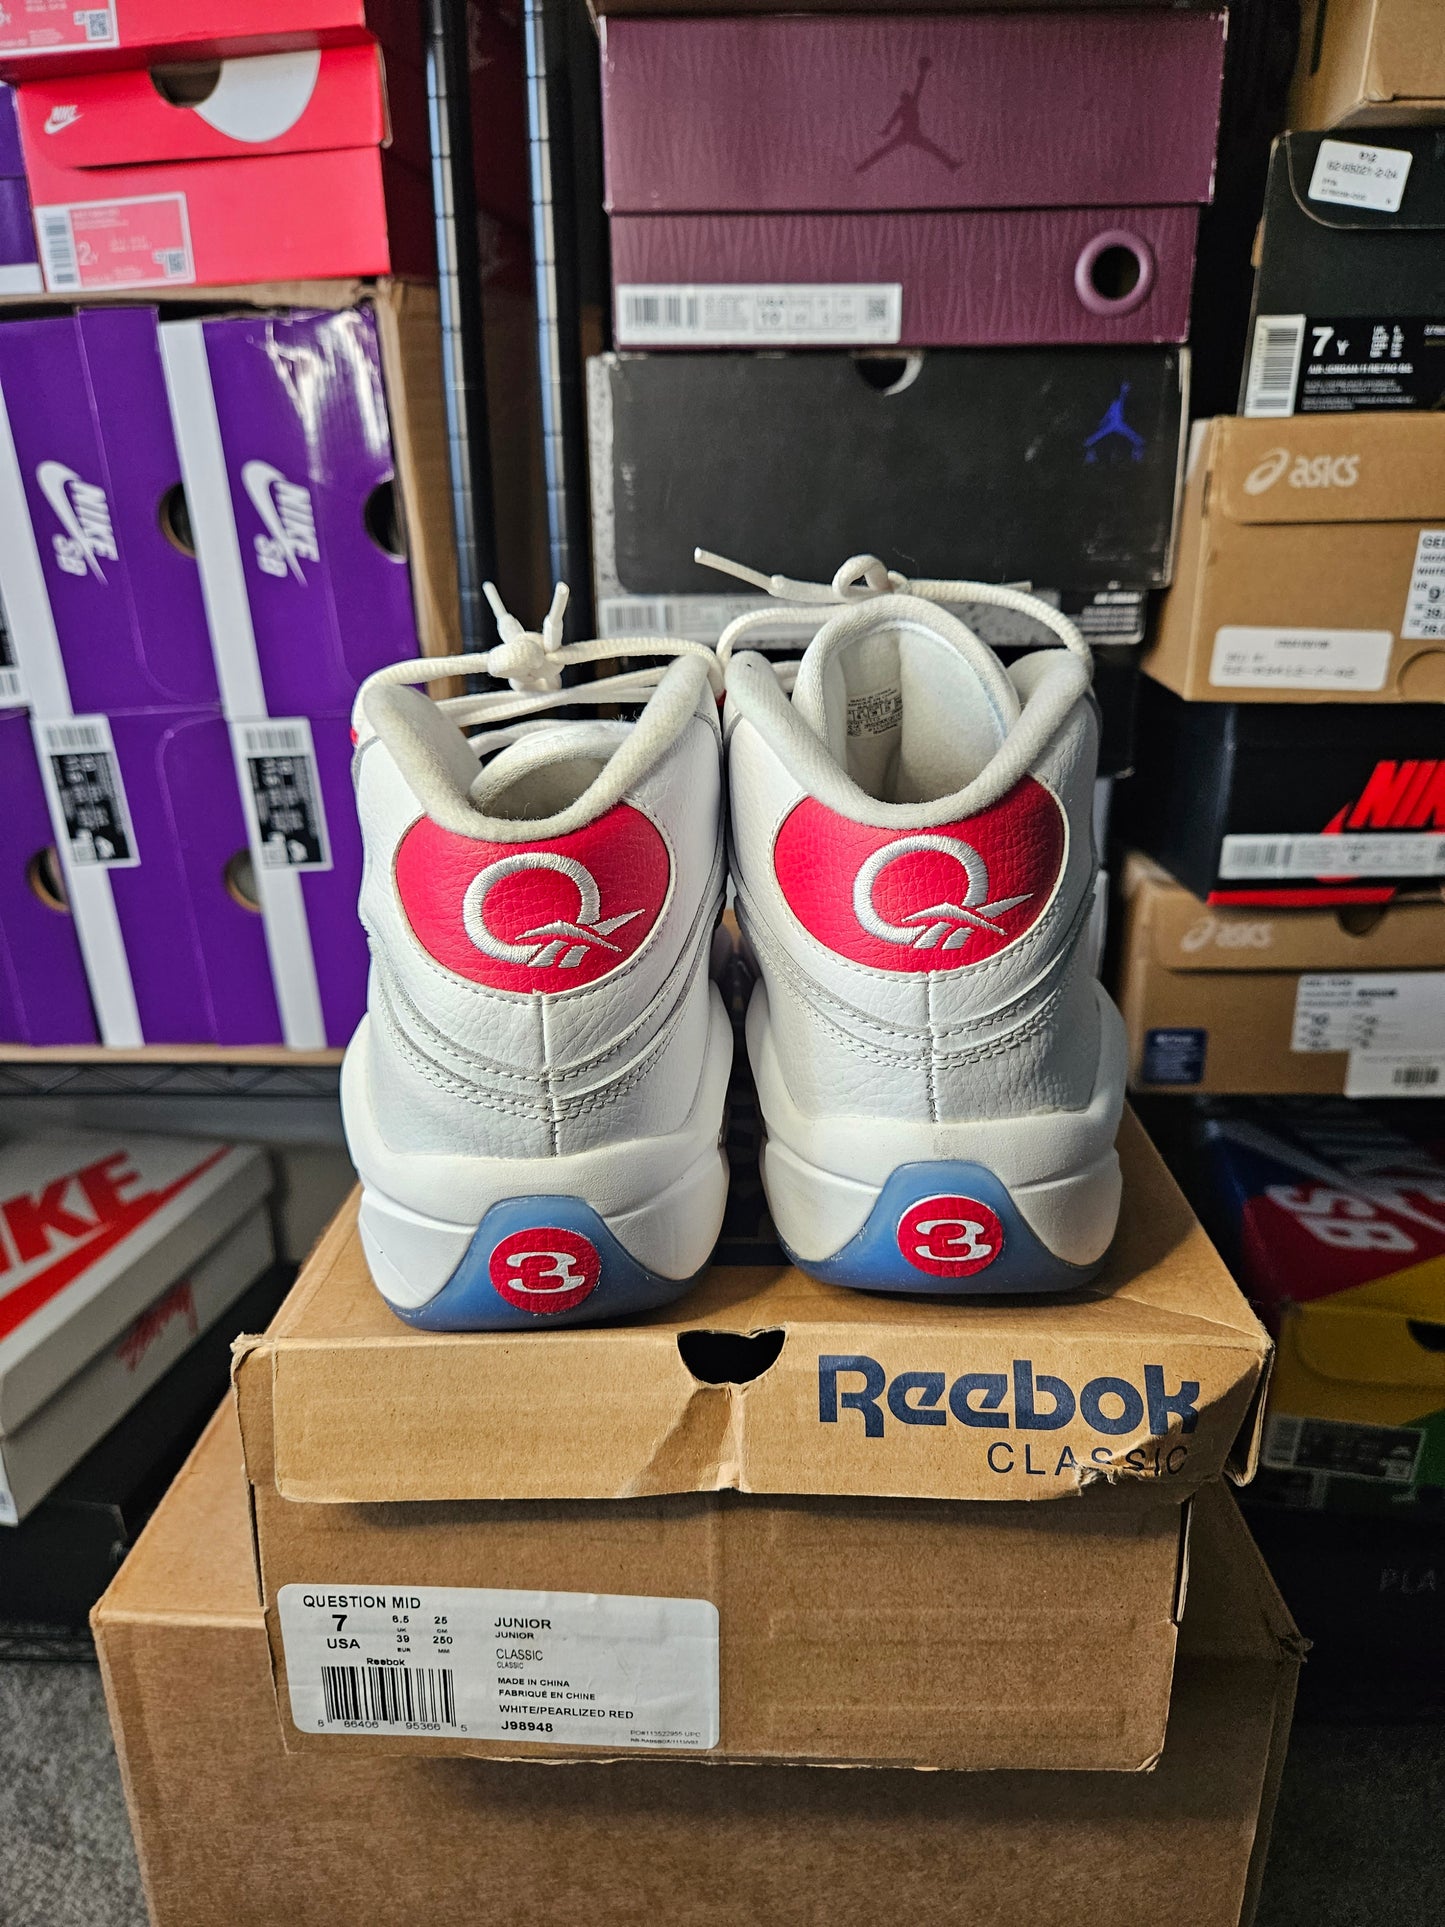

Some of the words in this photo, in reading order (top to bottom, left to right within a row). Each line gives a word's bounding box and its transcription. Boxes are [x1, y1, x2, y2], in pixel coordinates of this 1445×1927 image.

[1288, 454, 1360, 488] asics
[67, 479, 119, 561] NIKE
[274, 479, 320, 562] NIKE
[914, 1219, 993, 1262] 3
[506, 1251, 585, 1294] 3
[818, 1354, 1200, 1438] Reebok
[987, 1441, 1188, 1475] CLASSIC
[303, 1595, 386, 1608] QUESTION
[392, 1597, 421, 1609] MID
[331, 1614, 348, 1632] 7
[434, 1616, 448, 1625] 25
[494, 1617, 552, 1630] JUNIOR
[396, 1635, 410, 1643] 39
[432, 1636, 453, 1645] 250
[495, 1631, 535, 1640] JUNIOR
[326, 1638, 360, 1649] USA
[496, 1648, 543, 1661] CLASSIC
[366, 1658, 405, 1666] Reebok
[496, 1661, 524, 1670] CLASSIC
[497, 1677, 525, 1686] MADE
[527, 1678, 537, 1686] IN
[540, 1679, 570, 1688] CHINA
[498, 1689, 547, 1699] FABRIQUÉ
[550, 1691, 563, 1699] EN
[566, 1692, 596, 1701] CHINE
[499, 1704, 606, 1718] WHITE/PEARLIZED
[609, 1710, 634, 1719] RED
[344, 1720, 379, 1729] 86406
[405, 1721, 441, 1731] 95366
[460, 1724, 468, 1732] 5
[501, 1721, 553, 1733] J98948
